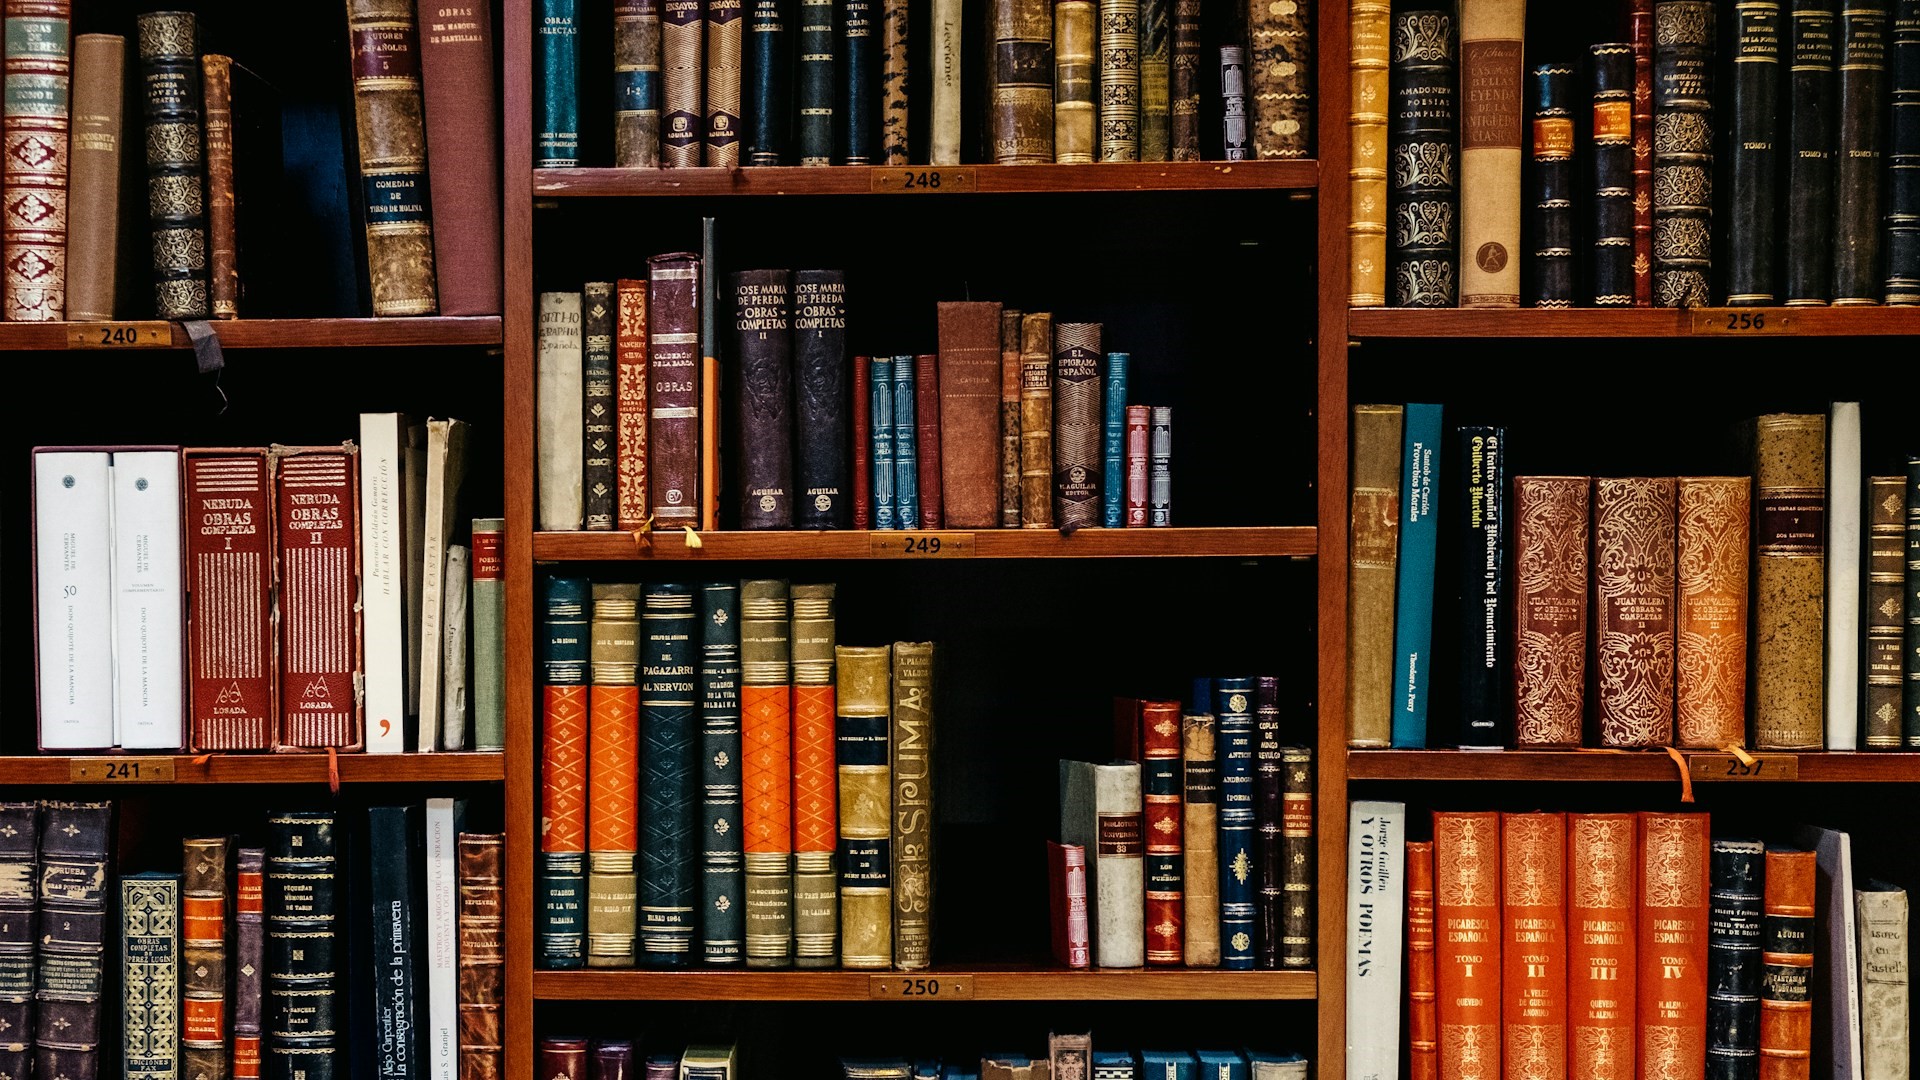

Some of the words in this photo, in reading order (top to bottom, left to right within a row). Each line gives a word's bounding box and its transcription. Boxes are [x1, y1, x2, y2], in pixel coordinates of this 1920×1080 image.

[665, 2, 698, 12] ENSAYOS
[709, 0, 741, 10] ENSAYOS
[439, 8, 472, 17] OBRAS
[545, 17, 572, 25] OBRAS
[539, 27, 577, 35] SELECTAS
[1472, 78, 1514, 86] BELLAS
[376, 180, 415, 189] COMEDIAS
[904, 171, 941, 188] 248
[390, 192, 402, 200] DE
[370, 205, 389, 213] TIRSO
[738, 296, 749, 306] DE
[751, 295, 785, 305] PEREDA
[797, 295, 808, 305] DE
[810, 294, 844, 304] PEREDA
[744, 307, 778, 319] OBRAS
[803, 305, 836, 317] OBRAS
[737, 318, 787, 331] COMPLETAS
[795, 317, 846, 329] COMPLETAS
[1727, 313, 1765, 330] 256
[100, 327, 138, 345] 240
[759, 332, 767, 340] II
[818, 330, 823, 338] I
[1058, 359, 1097, 367] EPIGRAMA
[1058, 366, 1097, 376] ESPAÑOL
[656, 381, 693, 392] OBRAS
[1486, 436, 1498, 450] El
[1411, 442, 1423, 488] Proverbios
[1423, 449, 1432, 471] Santob
[1471, 436, 1484, 485] Edilberto
[1486, 451, 1498, 481] teatro
[1422, 473, 1431, 484] de
[379, 458, 390, 526] CORRECCIÓN
[752, 488, 784, 496] AGUILAR
[807, 487, 839, 495] AGUILAR
[202, 499, 253, 510] NERUDA
[290, 494, 341, 505] NERUDA
[1421, 486, 1431, 516] Carrión
[1484, 482, 1497, 521] español
[1410, 489, 1421, 523] Morales
[203, 512, 252, 526] OBRAS
[290, 507, 339, 521] OBRAS
[200, 524, 257, 535] COMPLETAS
[289, 520, 344, 530] COMPLETAS
[224, 537, 232, 550] I
[310, 531, 323, 545] II
[381, 529, 390, 549] CON
[904, 537, 941, 554] 249
[1484, 523, 1498, 571] Medieval
[428, 536, 437, 587] CANTAR
[381, 553, 390, 595] HABLAR
[1484, 572, 1494, 580] y
[63, 585, 77, 599] 50
[1485, 581, 1497, 595] del
[1529, 598, 1551, 606] JUAN
[1552, 598, 1581, 606] VALERA
[1614, 598, 1637, 606] JUAN
[1638, 598, 1666, 606] VALERA
[1687, 598, 1710, 606] JUAN
[1711, 598, 1740, 606] VALERA
[1533, 613, 1577, 621] COMPLETAS
[1619, 613, 1663, 621] COMPLETAS
[1692, 613, 1737, 621] COMPLETAS
[427, 614, 435, 637] VER
[1484, 597, 1498, 668] Renacimiento
[643, 666, 694, 676] PAGAZARRI
[1408, 652, 1418, 684] Theodore
[643, 683, 653, 691] AL
[653, 682, 694, 692] NERVION
[709, 681, 734, 689] CUADROS
[1408, 683, 1417, 693] A.
[299, 701, 334, 710] LOSADA
[1406, 693, 1416, 713] Perry
[213, 707, 247, 715] LOSADA
[1259, 722, 1279, 730] COPLAS
[1264, 732, 1273, 740] DE
[1260, 741, 1278, 749] MINGO
[1258, 751, 1280, 759] REVULGO
[106, 763, 140, 779] 241
[1726, 759, 1764, 776] 257
[1360, 816, 1375, 832] Y
[1377, 816, 1391, 849] Jorge
[1116, 845, 1127, 853] 33
[1359, 834, 1375, 895] OTROS
[1378, 852, 1391, 892] Guillén
[549, 889, 575, 897] CUADROS
[555, 902, 564, 910] LA
[565, 902, 578, 910] VIDA
[63, 921, 71, 931] 2
[389, 900, 407, 954] primavera
[1447, 918, 1490, 929] PICARESCA
[1514, 918, 1556, 929] PICARESCA
[1583, 920, 1625, 932] PICARESCA
[1653, 919, 1696, 931] PICARESCA
[1358, 904, 1374, 978] POEMAS
[1448, 930, 1489, 943] ESPAÑOLA
[1515, 930, 1555, 943] ESPAÑOLA
[1583, 932, 1624, 945] ESPAÑOLA
[1654, 931, 1694, 944] ESPAÑOLA
[130, 944, 168, 952] COMPLETAS
[390, 956, 403, 966] la
[1455, 955, 1483, 964] TOMO
[1522, 955, 1550, 964] TOMO
[1589, 957, 1618, 966] TOMO
[1660, 956, 1688, 965] TOMO
[1464, 964, 1474, 977] I
[1527, 964, 1546, 978] II
[1590, 966, 1618, 980] III
[1663, 965, 1686, 979] IV
[390, 969, 404, 987] de
[902, 979, 939, 995] 250
[1456, 997, 1483, 1007] QUEVEDO
[1590, 1000, 1618, 1009] QUEVEDO
[382, 1006, 395, 1053] Carpentier
[391, 988, 410, 1063] consagración
[440, 1027, 448, 1056] Granjel
[383, 1054, 396, 1076] Alejo
[394, 1063, 407, 1076] La
